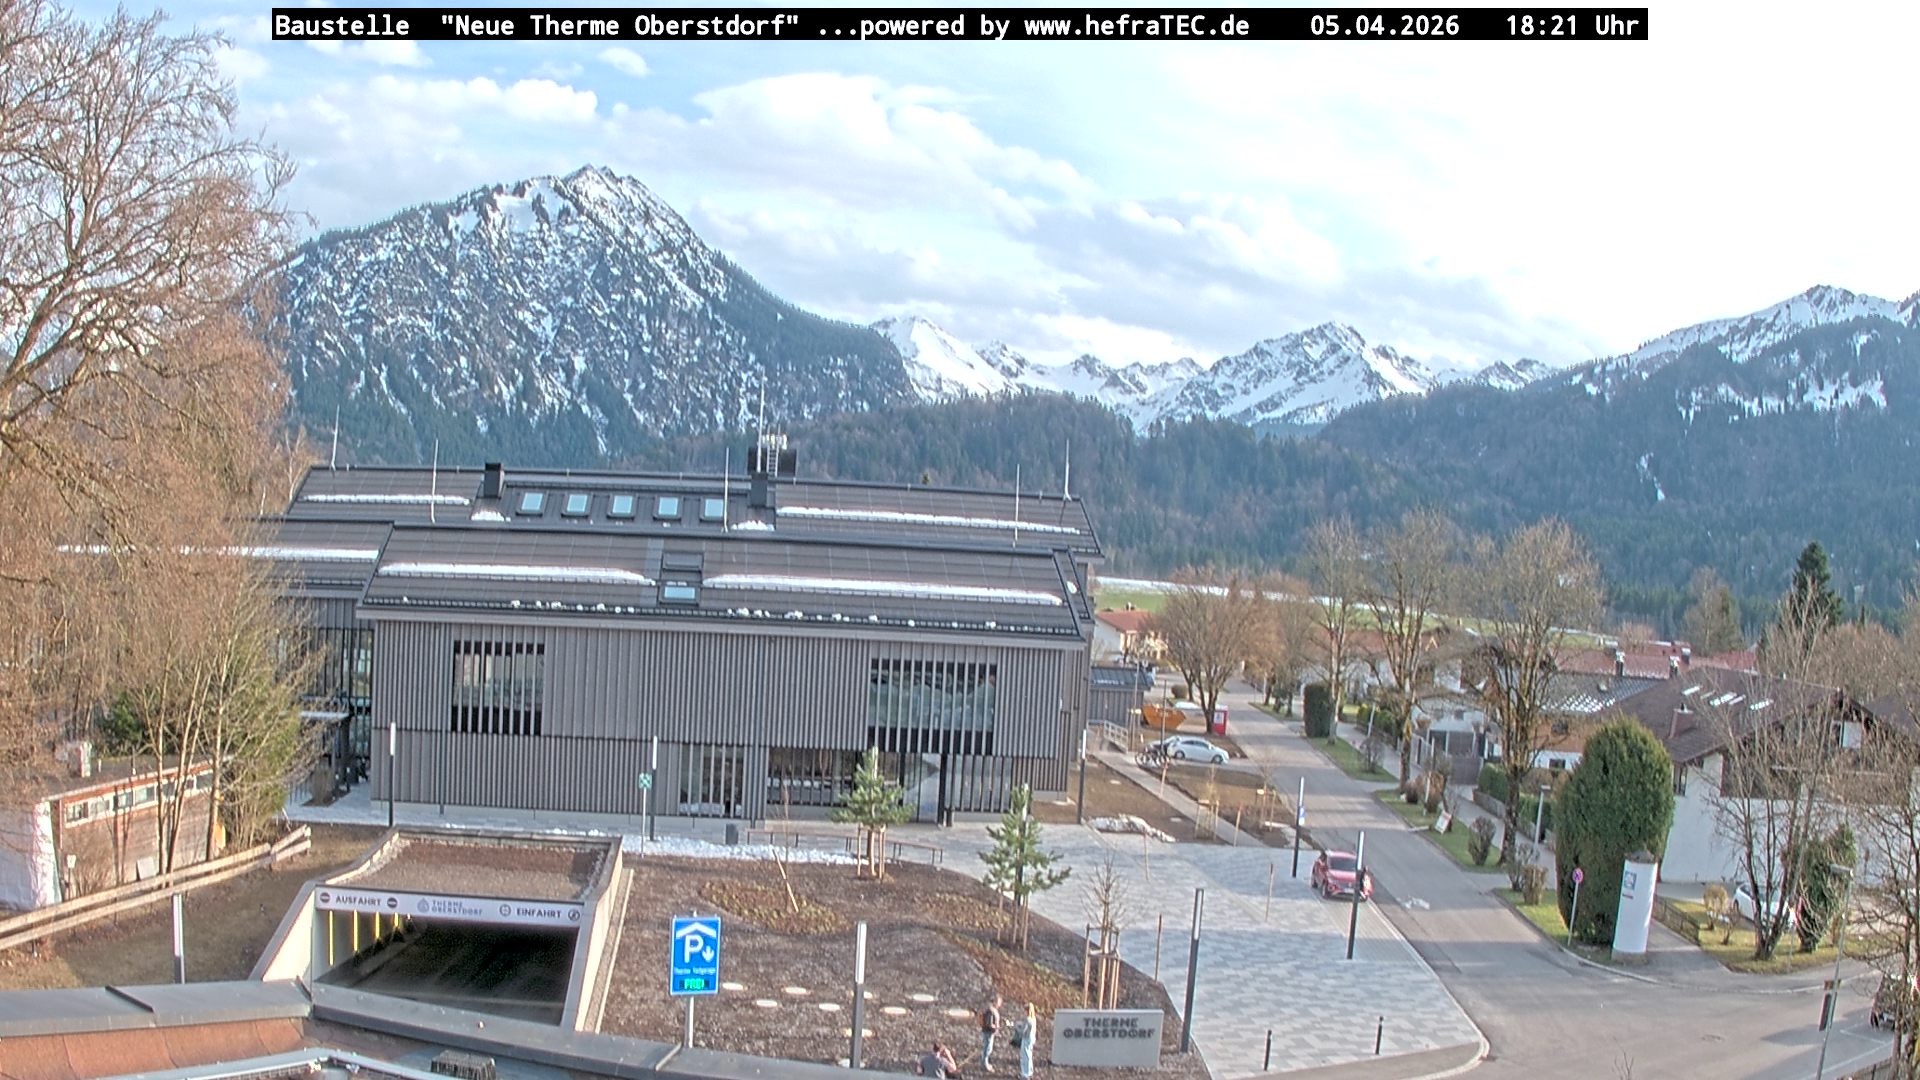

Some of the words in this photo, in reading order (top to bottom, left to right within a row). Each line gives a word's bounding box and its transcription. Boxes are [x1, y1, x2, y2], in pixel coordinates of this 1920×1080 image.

[335, 895, 382, 907] AUSFAHRT
[516, 907, 562, 919] EINFAHRT
[684, 934, 704, 963] P
[1083, 1017, 1139, 1028] THERME
[1063, 1027, 1155, 1039] OBERSTDORF
